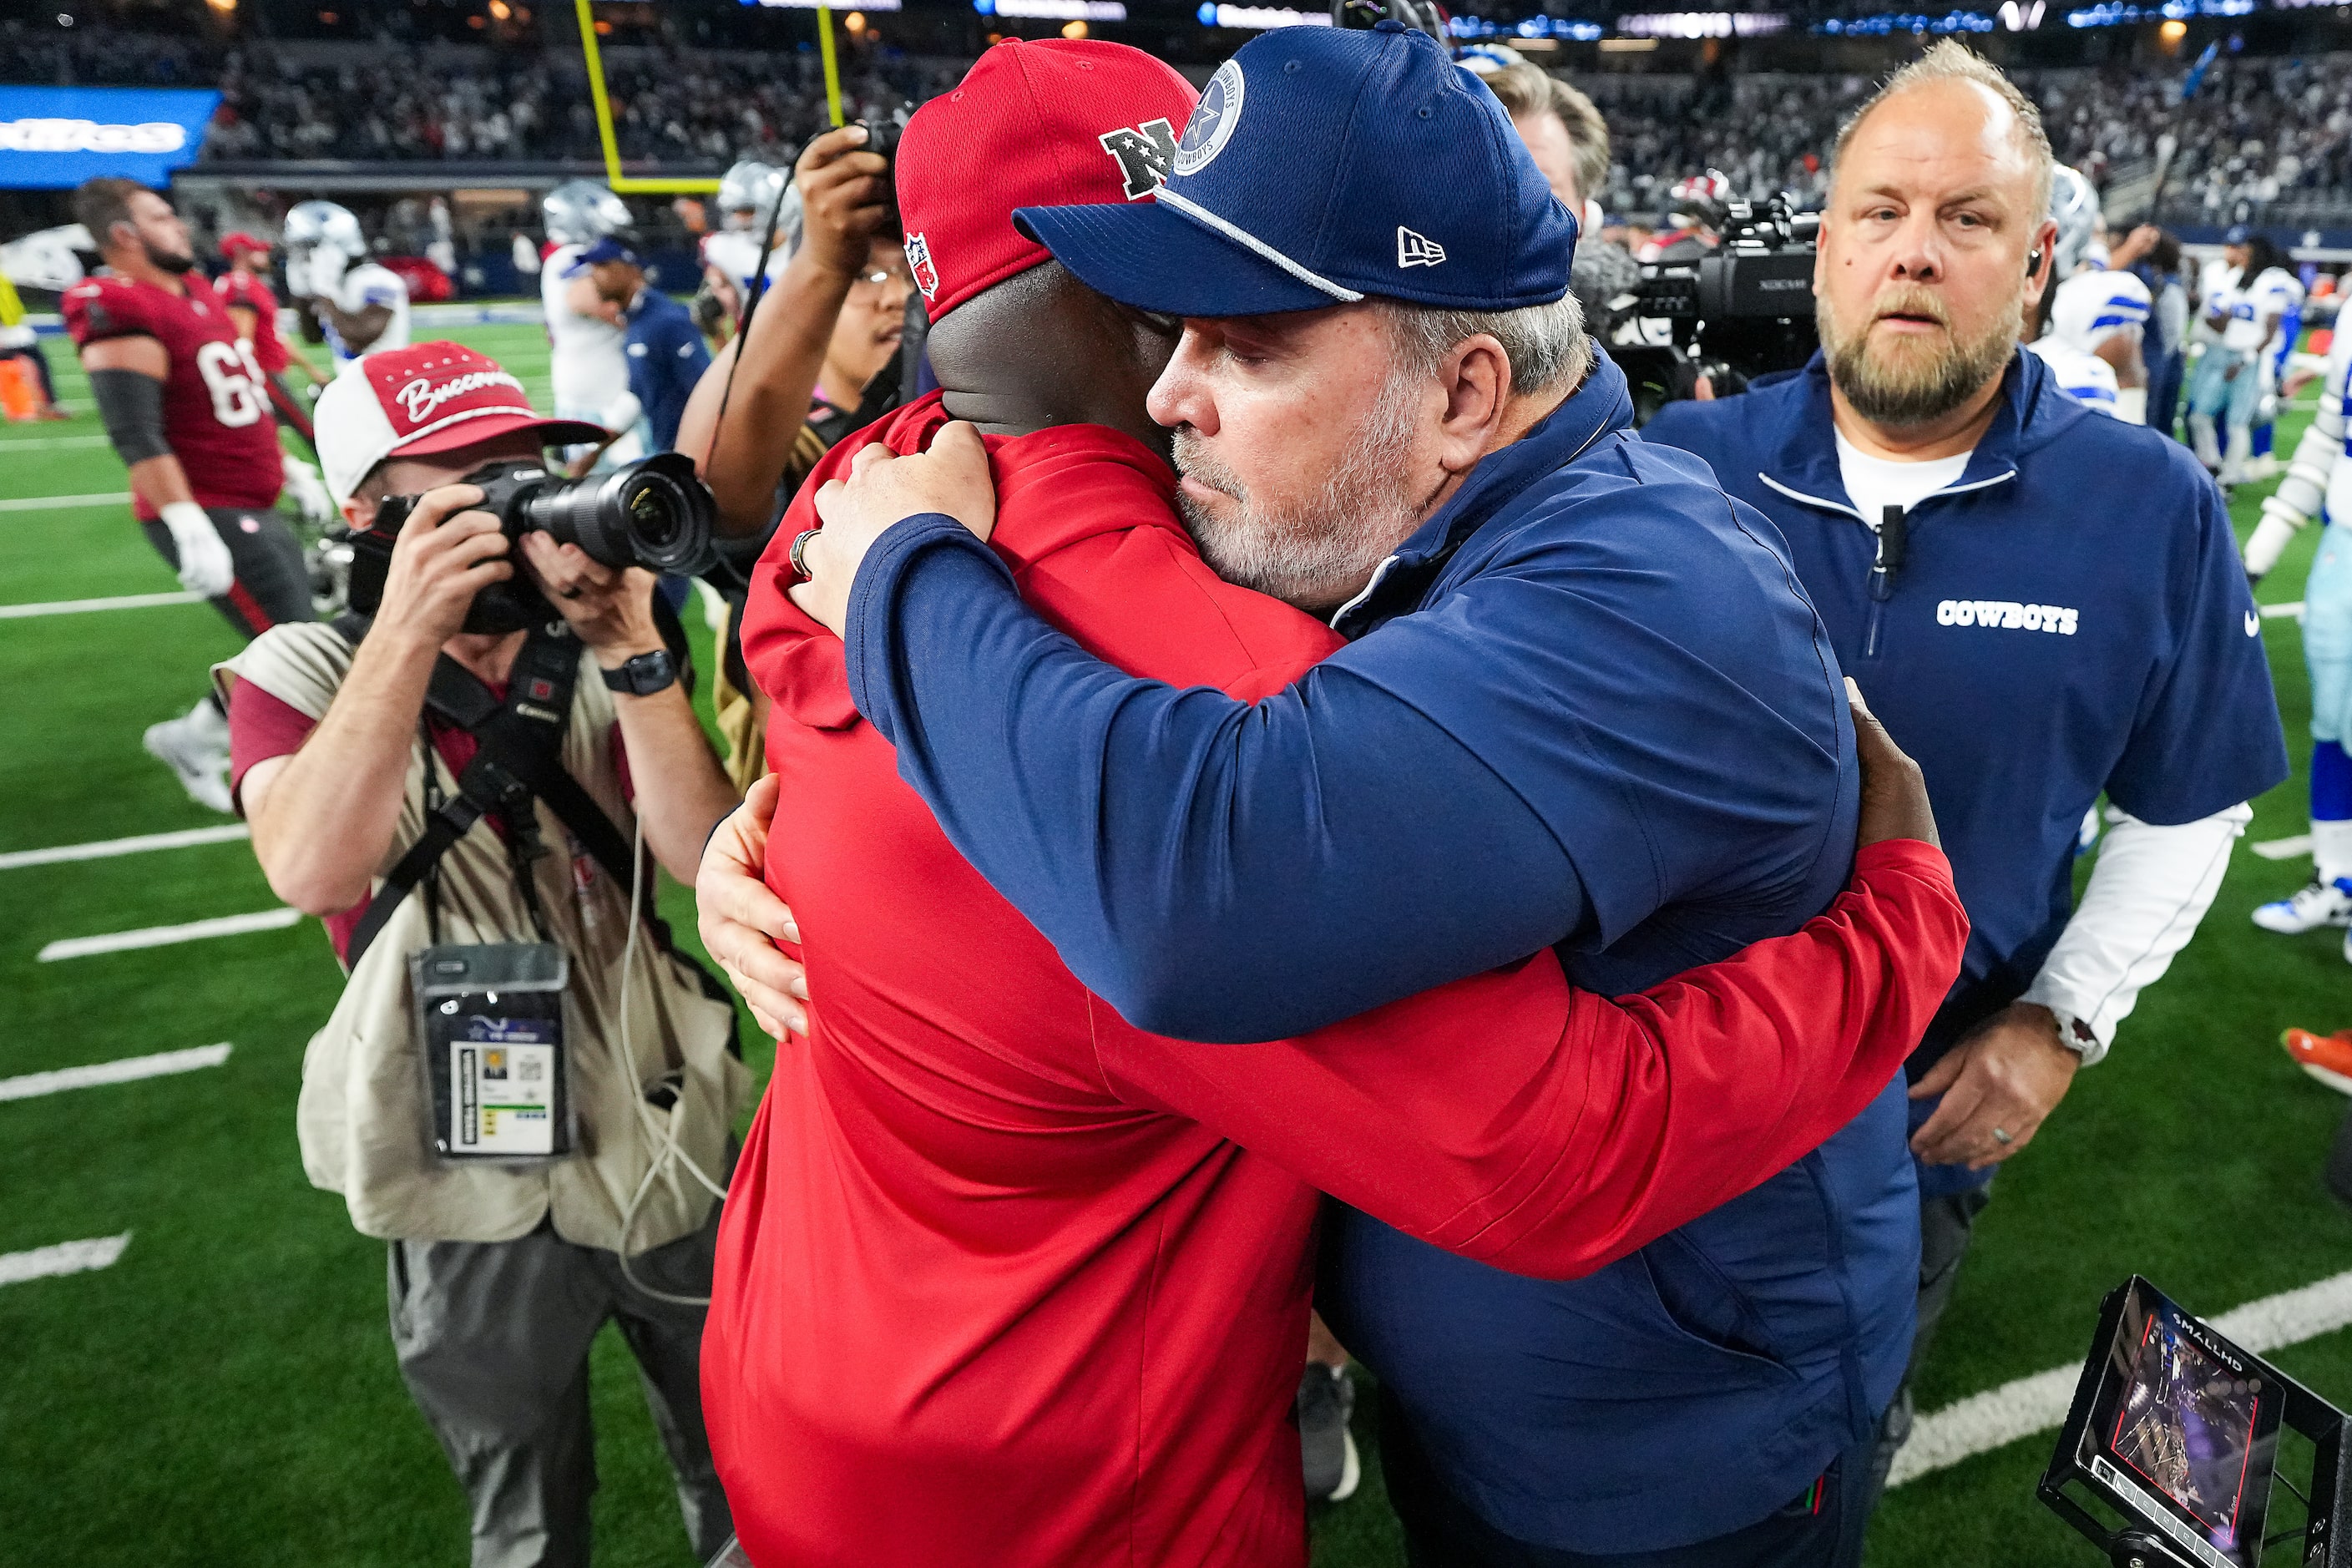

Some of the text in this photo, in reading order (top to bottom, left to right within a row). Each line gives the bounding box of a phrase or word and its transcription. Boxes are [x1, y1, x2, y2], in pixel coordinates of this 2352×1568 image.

[1217, 68, 1237, 109] COWBOYS
[1177, 140, 1213, 165] COWBOYS
[1936, 599, 2079, 635] COWBOYS
[2172, 1313, 2243, 1373] SMALLHD
